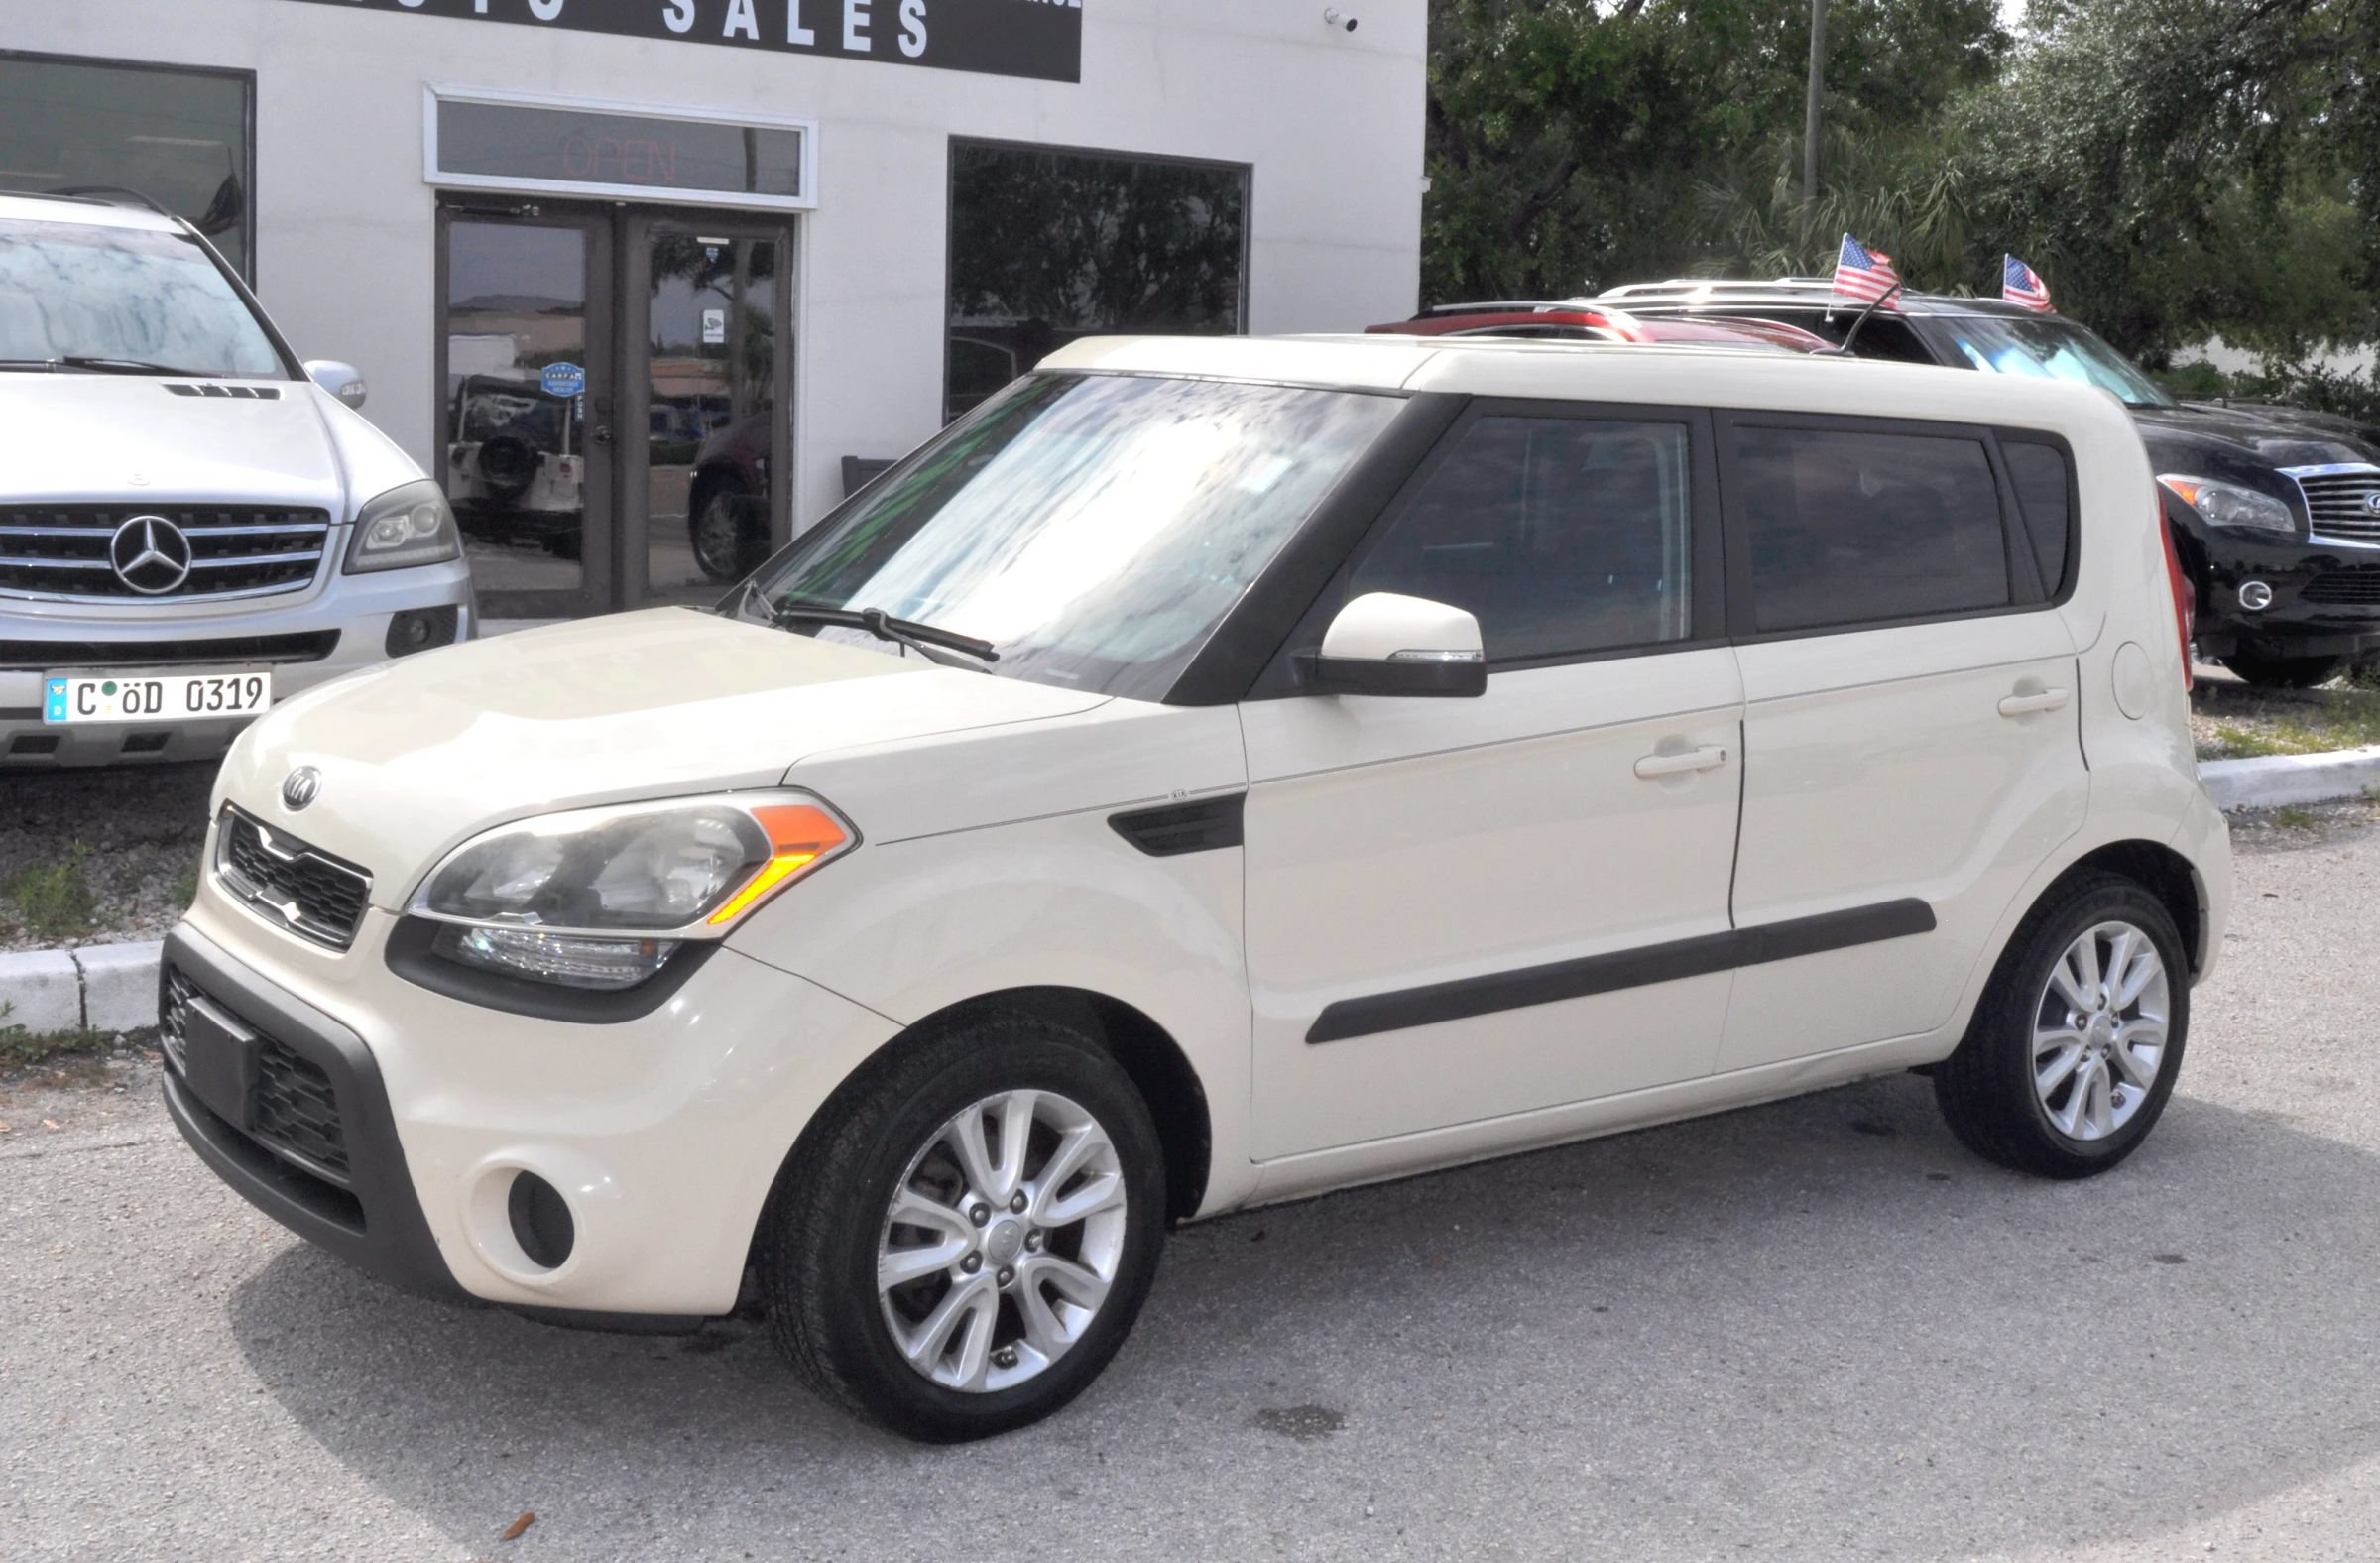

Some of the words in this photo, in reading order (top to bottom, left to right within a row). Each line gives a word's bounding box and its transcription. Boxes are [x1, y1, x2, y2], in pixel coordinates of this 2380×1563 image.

[662, 0, 927, 58] SALES
[562, 135, 678, 181] OPEN
[77, 683, 96, 715] C
[186, 677, 263, 712] 0319
